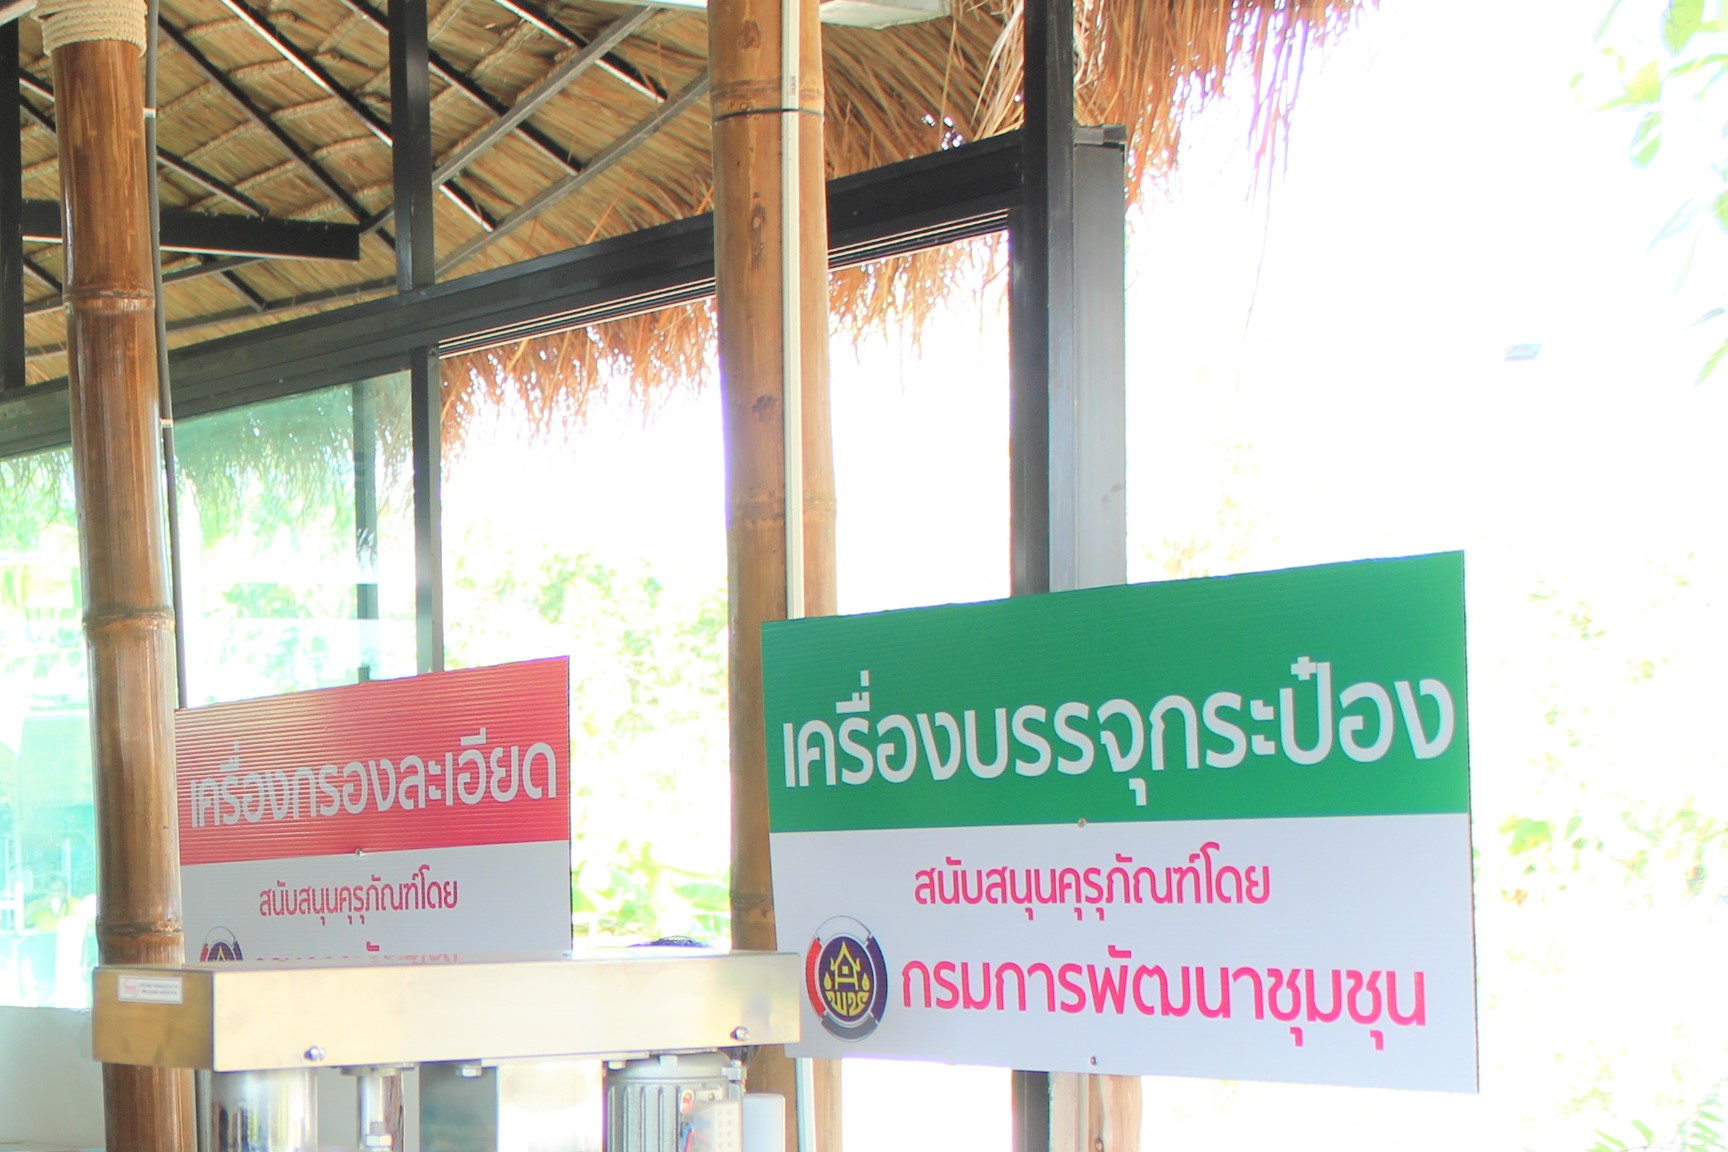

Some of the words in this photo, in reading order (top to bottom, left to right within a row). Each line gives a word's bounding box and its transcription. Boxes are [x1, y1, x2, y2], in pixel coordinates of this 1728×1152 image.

[190, 726, 557, 828] เครื่องกรองละเอียด
[782, 655, 1455, 807] เครื่องบรรจุกระป๋อง
[914, 842, 1272, 921] สนับสนุนคุรุภัณฑ์โดย
[901, 945, 1427, 1051] กรมการพัฒนาชุมชุน
